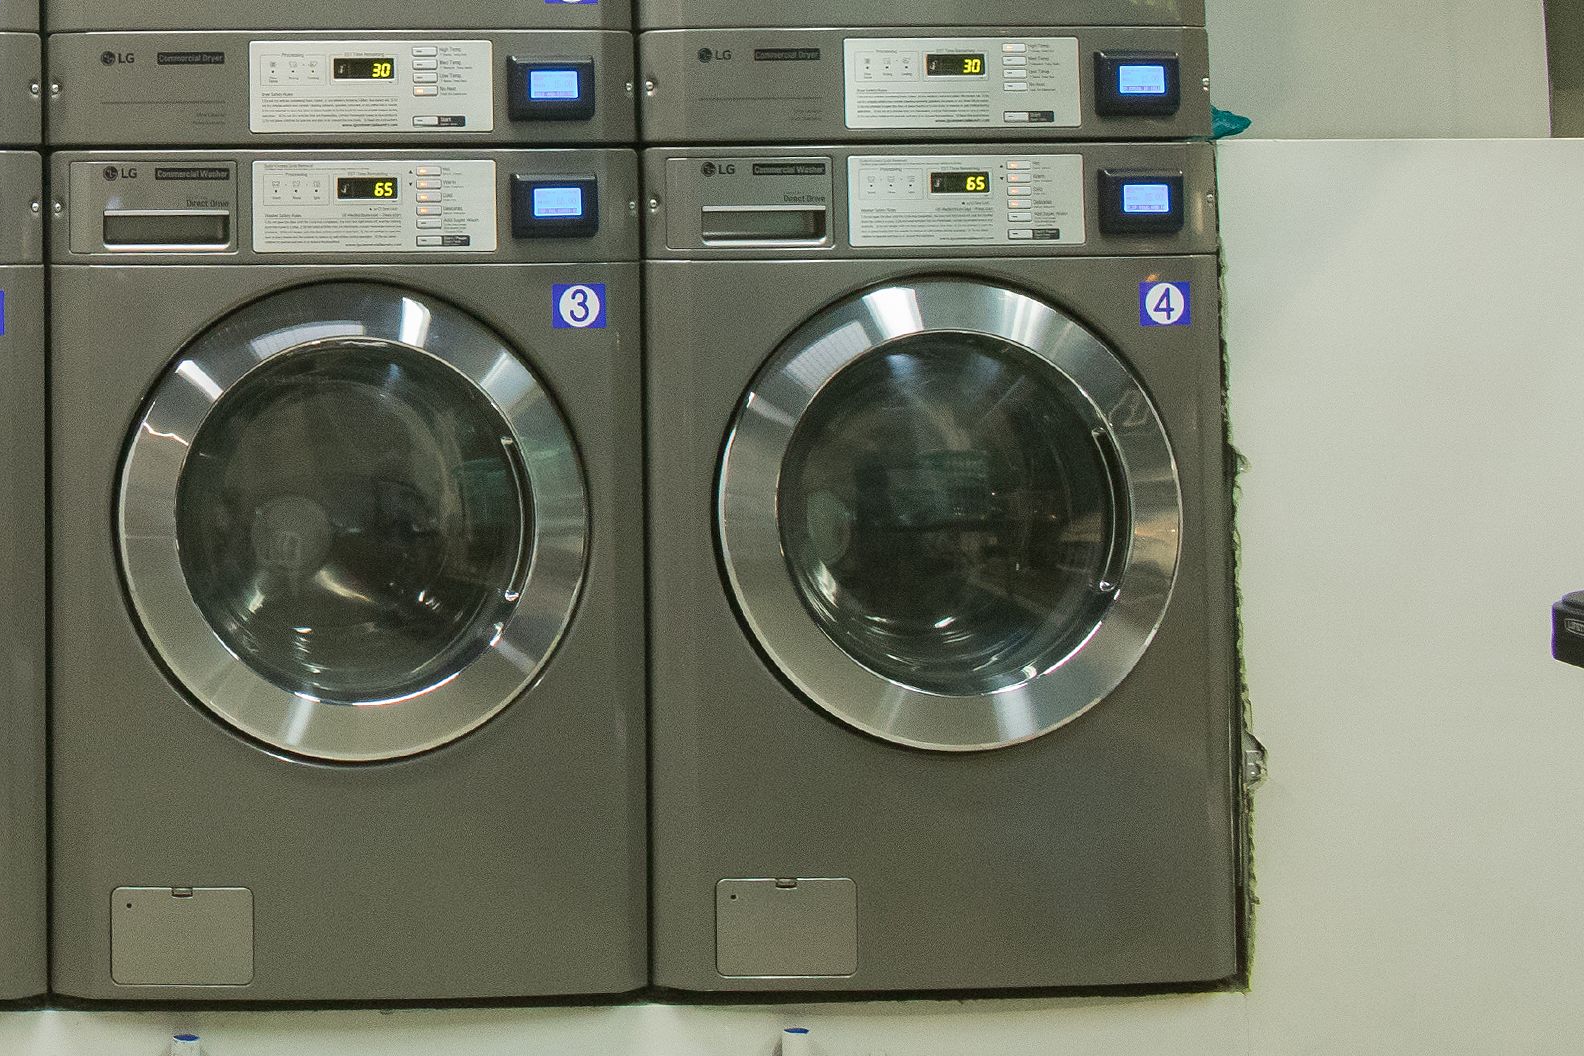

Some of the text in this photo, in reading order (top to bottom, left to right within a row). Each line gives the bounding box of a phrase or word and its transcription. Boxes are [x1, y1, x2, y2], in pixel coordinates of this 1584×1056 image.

[118, 53, 135, 63] LG
[716, 50, 732, 60] LG
[371, 62, 391, 78] 30
[962, 58, 981, 74] 30
[121, 168, 137, 179] LG
[718, 164, 735, 175] LG
[374, 181, 393, 197] 65
[965, 176, 986, 191] 65
[570, 289, 590, 323] 3
[1153, 288, 1174, 320] 4
